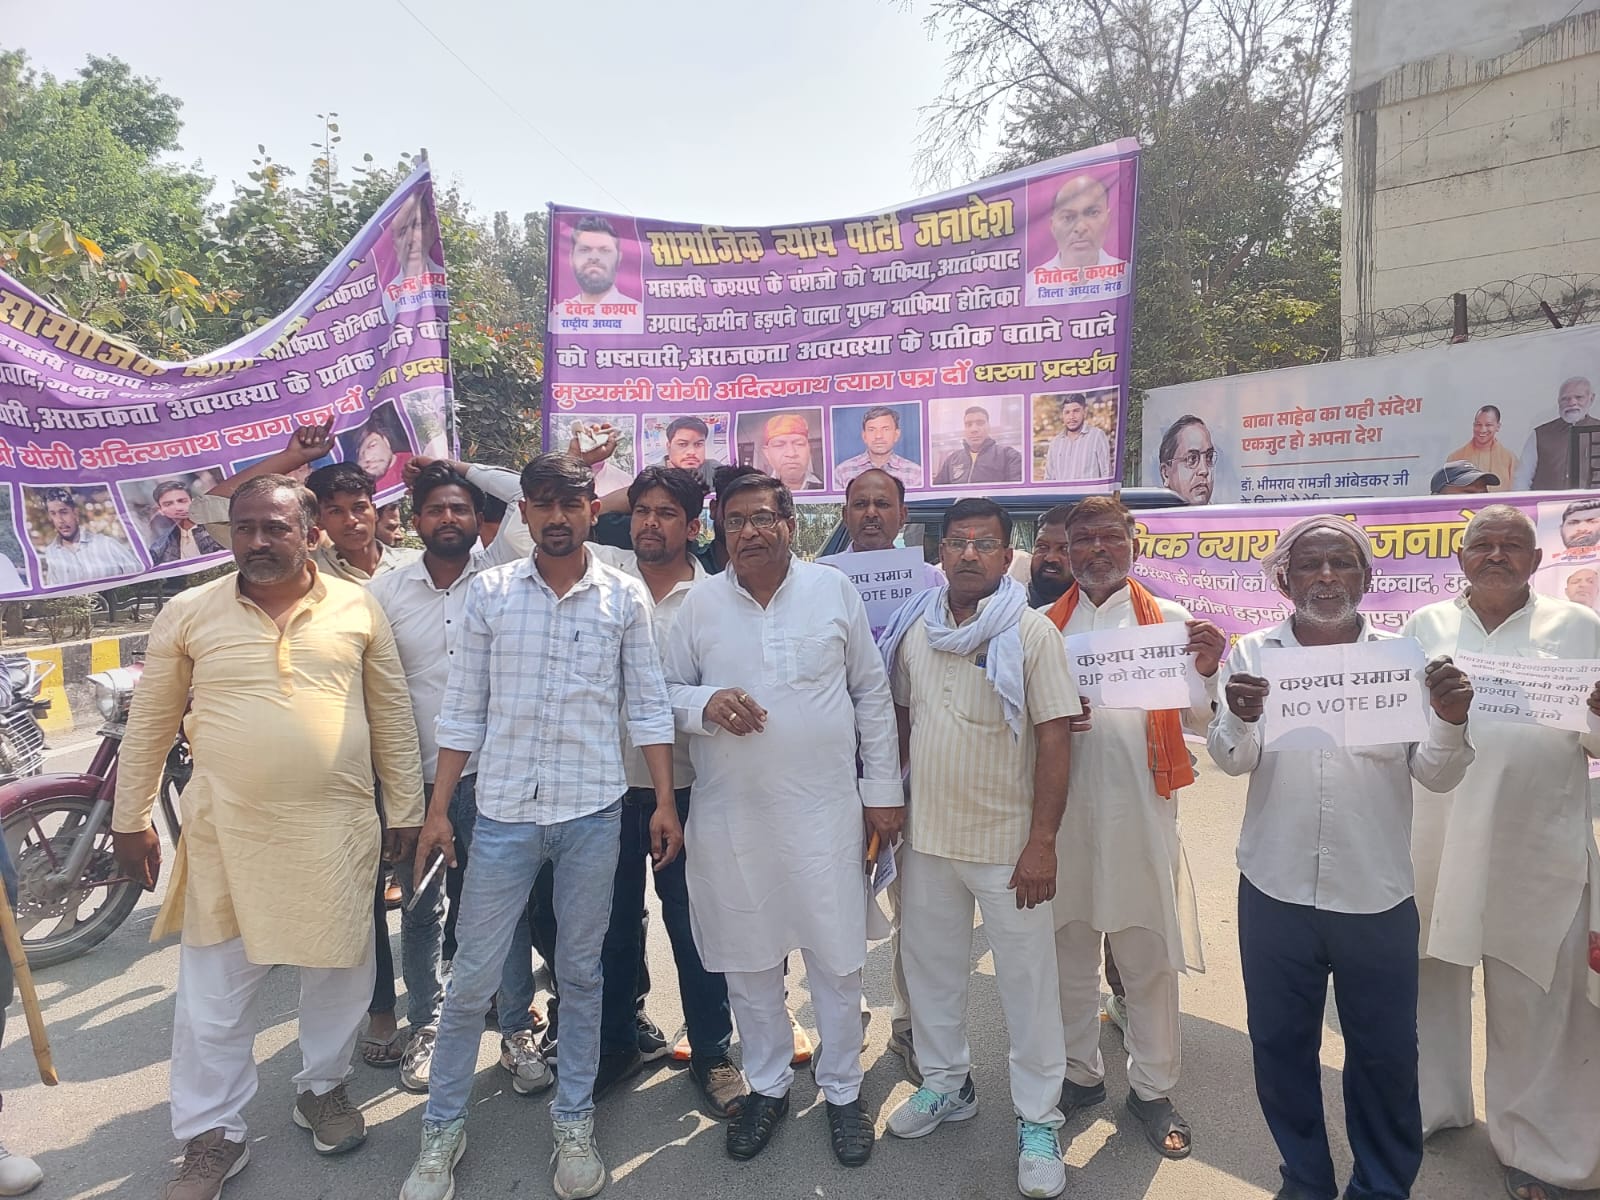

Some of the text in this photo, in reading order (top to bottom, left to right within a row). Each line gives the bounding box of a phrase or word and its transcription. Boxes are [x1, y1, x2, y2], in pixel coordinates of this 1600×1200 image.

[647, 224, 764, 266] सामाजिक
[771, 225, 838, 258] न्याय
[913, 194, 1015, 248] जनादेश
[711, 276, 761, 297] कश्यप
[765, 269, 784, 294] के
[842, 266, 867, 289] को
[1084, 262, 1127, 280] कश्यप
[1038, 286, 1064, 298] जिला
[600, 303, 638, 316] कश्यप
[803, 303, 840, 325] वाला
[846, 303, 885, 328] गुण्डा
[891, 293, 952, 318] माफिया
[956, 285, 1021, 312] होलिका
[330, 306, 387, 343] होलिका
[556, 344, 588, 367] को
[899, 329, 924, 352] के
[930, 324, 994, 350] प्रतीक
[1001, 318, 1062, 344] बताने
[1070, 312, 1117, 339] वाले
[283, 370, 310, 394] के
[317, 349, 375, 387] प्रतीक
[552, 378, 654, 408] मुख्यमंत्री
[657, 375, 711, 401] योगी
[716, 373, 831, 400] अदित्यनाथ
[834, 371, 894, 392] त्याग
[899, 367, 936, 388] पत्र
[974, 361, 1036, 383] धरना
[1042, 349, 1118, 381] प्रदर्शन
[1242, 395, 1423, 429] बाबा साहेब का यही संदेश
[16, 441, 77, 470] योगी
[80, 432, 220, 470] अदित्यनाथ
[221, 415, 293, 446] त्याग
[1241, 424, 1383, 455] एकजुट हो अपना देश
[1257, 476, 1295, 490] भीमराव
[1298, 473, 1331, 489] रामजी
[1334, 472, 1390, 488] आंबेडकर
[1392, 469, 1410, 487] जी
[875, 569, 912, 582] समाज
[1243, 571, 1267, 592] को
[859, 587, 912, 602] OTE BJP
[1076, 649, 1135, 667] कश्यप
[1079, 673, 1104, 686] BJP
[1108, 669, 1128, 683] को
[1132, 666, 1156, 680] वोट
[1159, 667, 1177, 678] ना
[1279, 668, 1412, 691] कश्यप समाज
[1282, 693, 1408, 717] NO VOTE BJP
